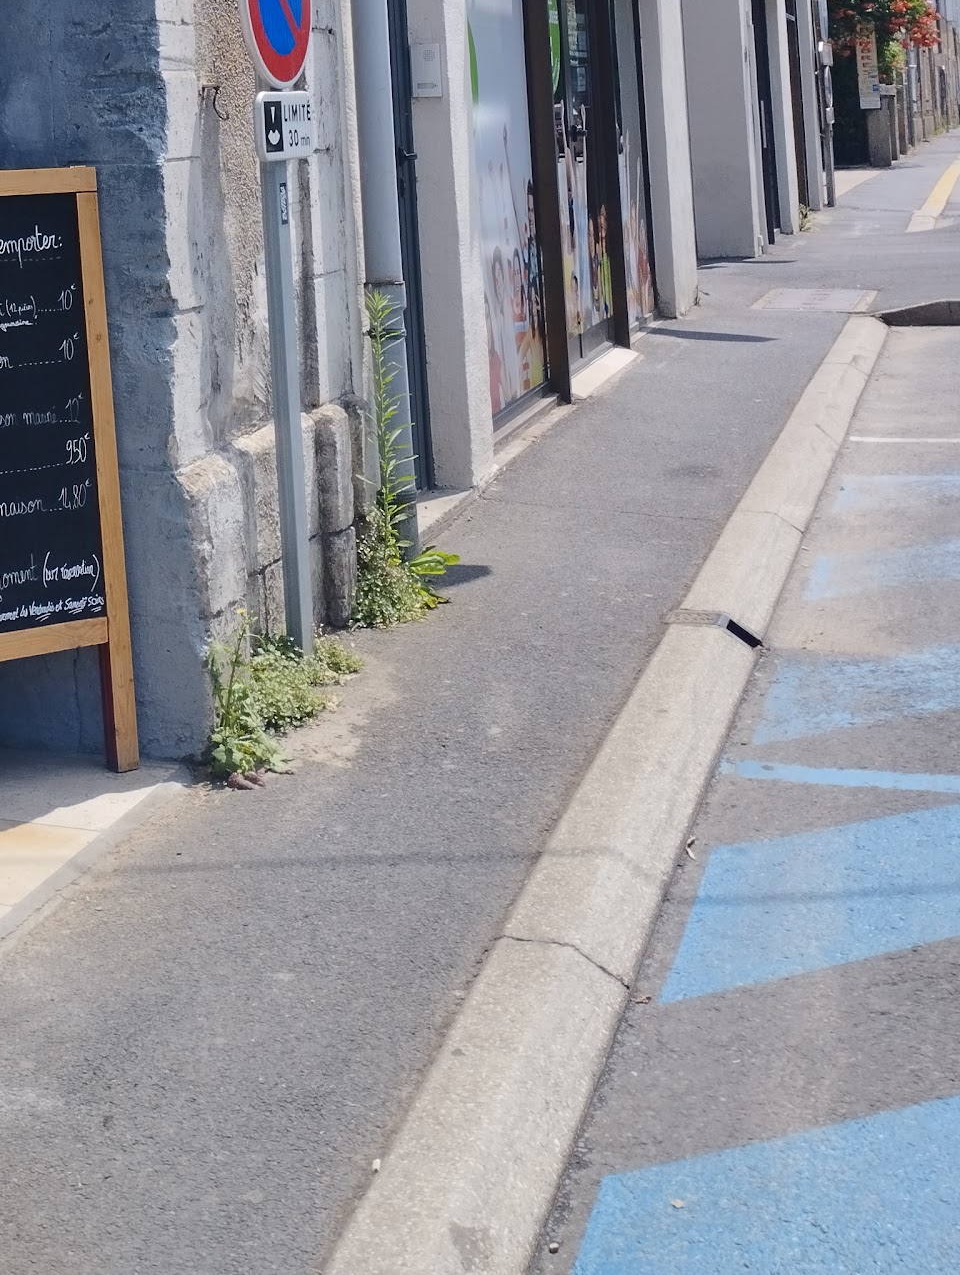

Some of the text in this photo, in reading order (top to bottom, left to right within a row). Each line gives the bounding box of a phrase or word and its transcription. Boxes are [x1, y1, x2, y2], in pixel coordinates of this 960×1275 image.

[283, 99, 311, 122] LIMITÉ
[288, 129, 310, 147] 30 min
